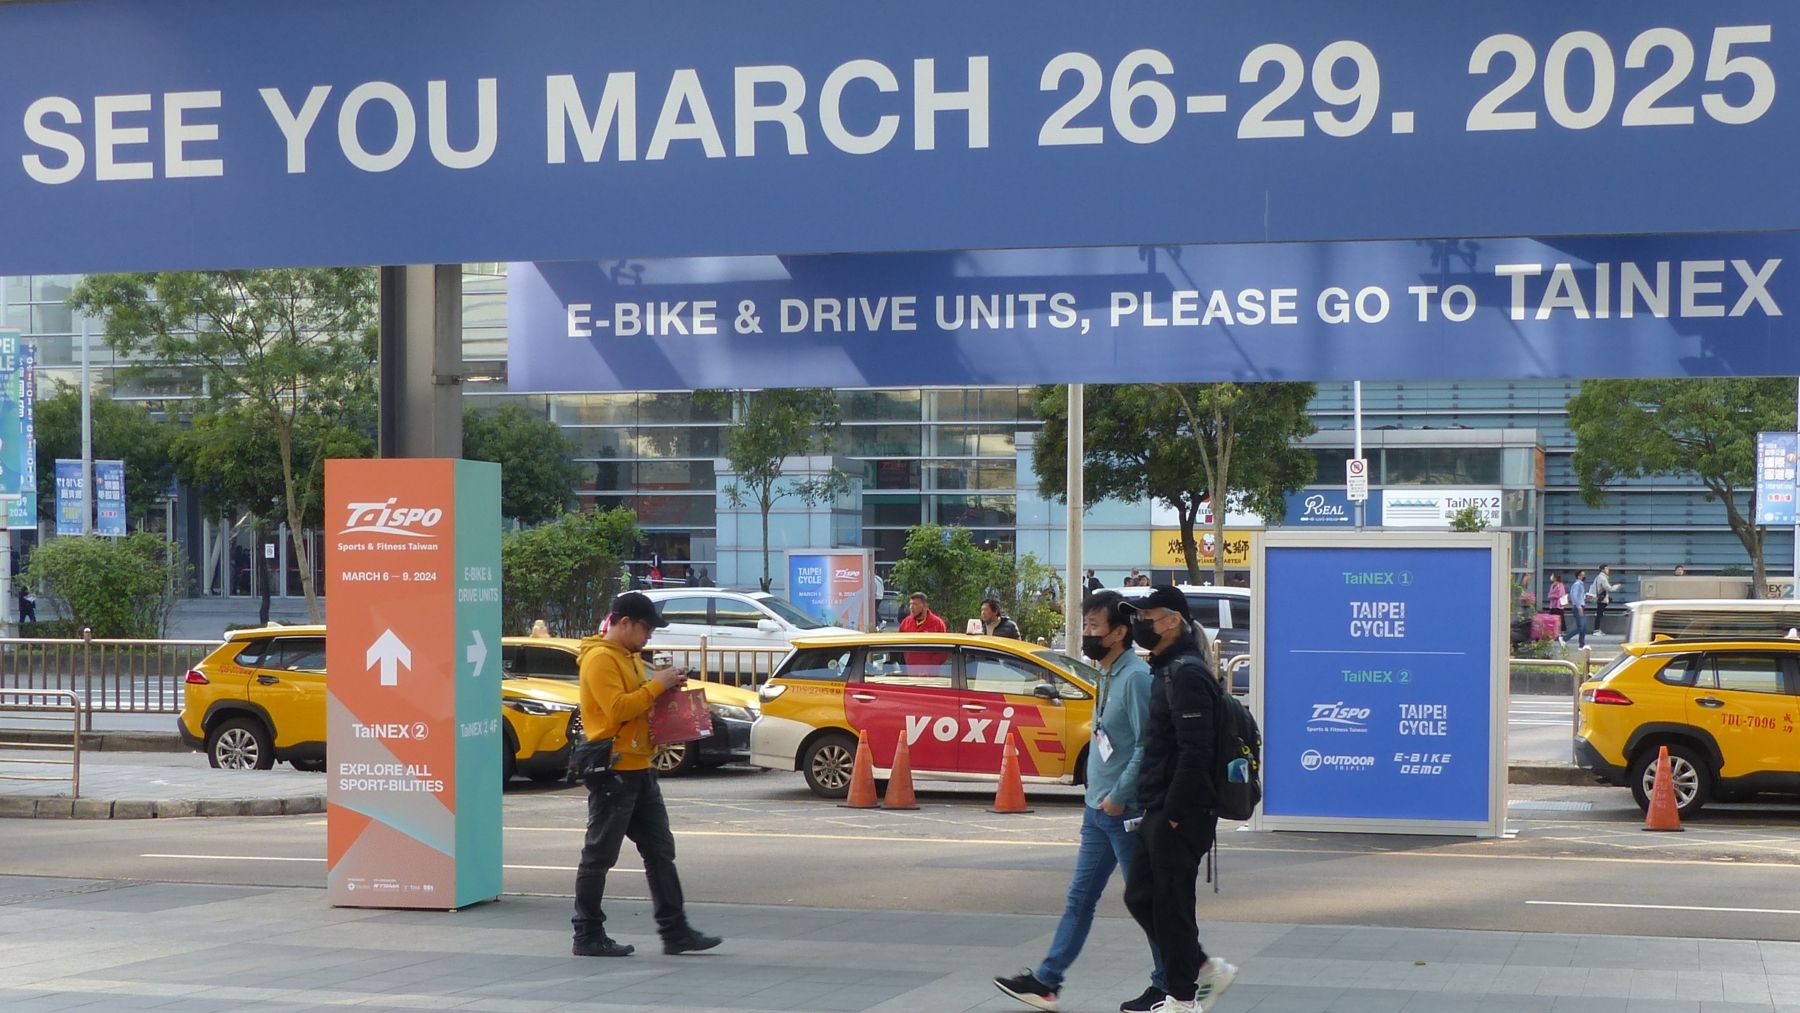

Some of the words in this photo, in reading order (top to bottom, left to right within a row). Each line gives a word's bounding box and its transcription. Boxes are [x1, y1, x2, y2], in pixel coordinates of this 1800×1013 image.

[22, 91, 224, 185] SEE
[259, 78, 498, 173] YOU
[546, 55, 990, 164] MARCH
[1038, 40, 1415, 146] 26-29.
[1466, 25, 1776, 131] 2025
[566, 300, 718, 338] E-BIKE
[734, 300, 764, 335] &
[779, 296, 917, 334] DRIVE
[934, 292, 1091, 336] UNITS,
[1110, 288, 1298, 328] PLEASE
[1316, 285, 1391, 324] GO
[1407, 284, 1477, 323] TO
[1494, 258, 1783, 321] TAINEX
[1304, 494, 1344, 515] REAL
[1445, 497, 1488, 508] TaiNEX
[1491, 497, 1500, 508] 2
[337, 543, 366, 552] Sports
[367, 542, 374, 550] &
[376, 542, 406, 551] Fitness
[408, 542, 438, 551] Taiwan
[342, 572, 381, 582] MARCH
[382, 572, 389, 581] 6
[402, 572, 411, 581] 9.
[413, 572, 437, 581] 2024
[464, 567, 486, 581] E-BIKE
[1342, 571, 1394, 585] TaiNEX
[458, 588, 478, 602] DRIVE
[478, 587, 499, 602] UNITS
[1350, 602, 1405, 619] TAIPEI
[1350, 620, 1405, 638] CYCLE
[1341, 670, 1393, 683] TaiNEX
[1398, 703, 1447, 720] TAIPEI
[904, 706, 1015, 747] voxi
[1398, 720, 1447, 736] CYCLE
[1721, 713, 1777, 730] TDU-7096
[352, 724, 410, 738] TaiNEX
[461, 721, 483, 738] TaiNEX
[1323, 755, 1375, 766] OUTDOOR
[1394, 753, 1452, 763] E-BIKE
[339, 764, 403, 776] EXPLORE
[406, 764, 432, 776] ALL
[1400, 765, 1443, 775] DEMO
[339, 779, 444, 792] SPORT-BILITIES
